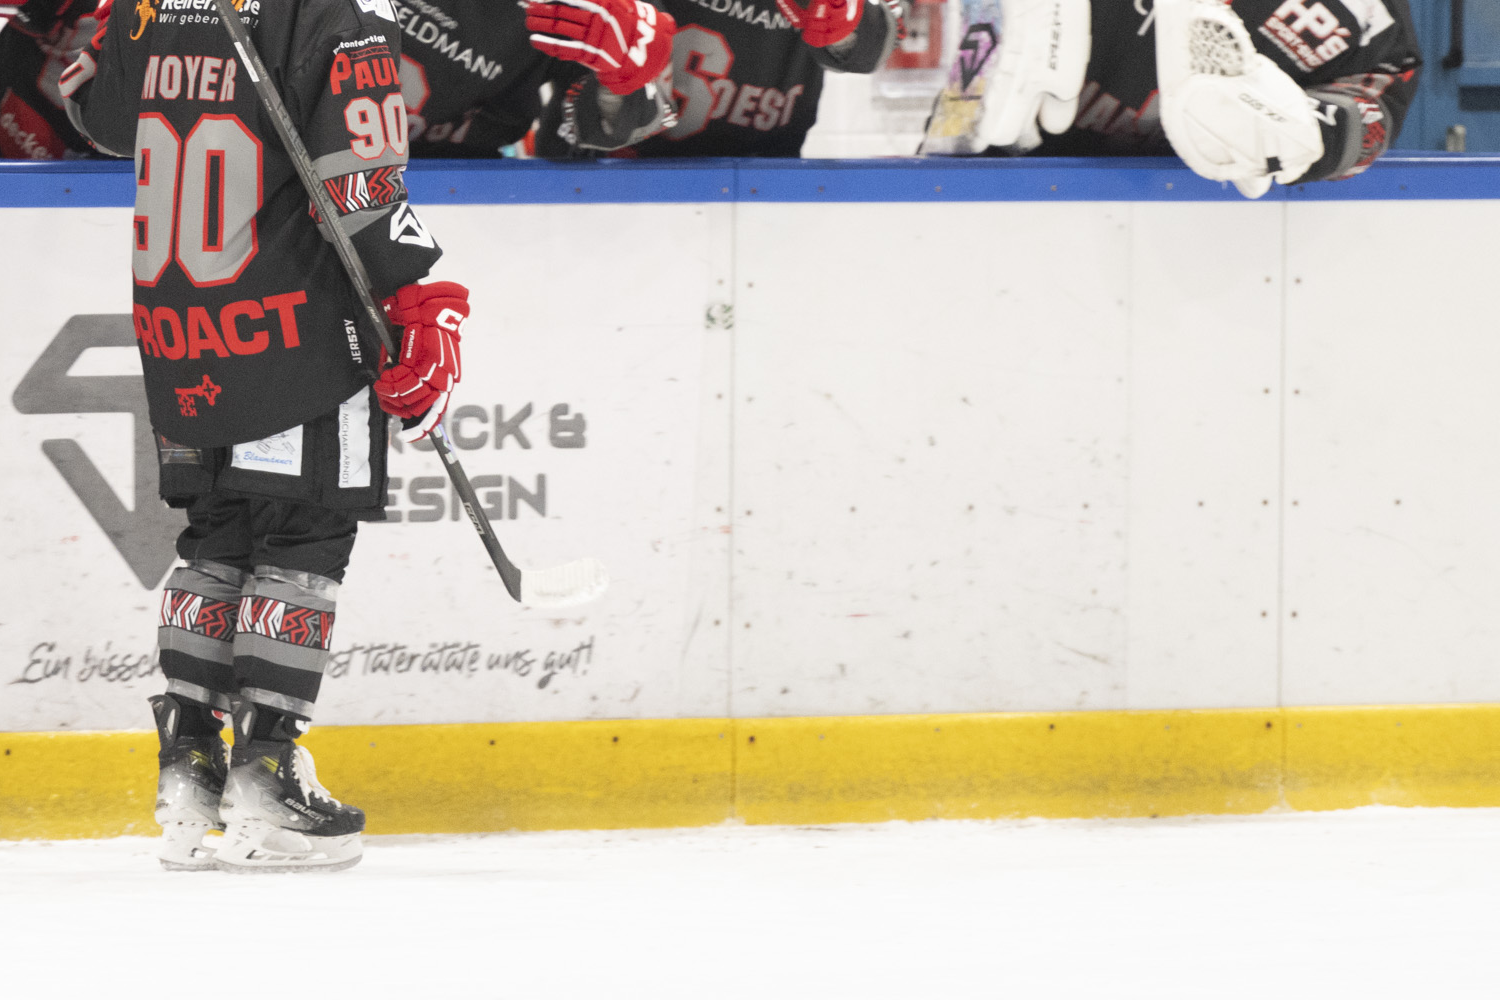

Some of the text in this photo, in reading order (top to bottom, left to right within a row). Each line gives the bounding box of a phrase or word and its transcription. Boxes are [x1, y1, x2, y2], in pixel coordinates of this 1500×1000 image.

[159, 12, 219, 25] Wir geben
[141, 55, 238, 103] MOYER
[343, 91, 409, 161] 90
[131, 110, 264, 289] 90
[341, 413, 350, 453] MICHAEL
[340, 455, 351, 485] ARNDT
